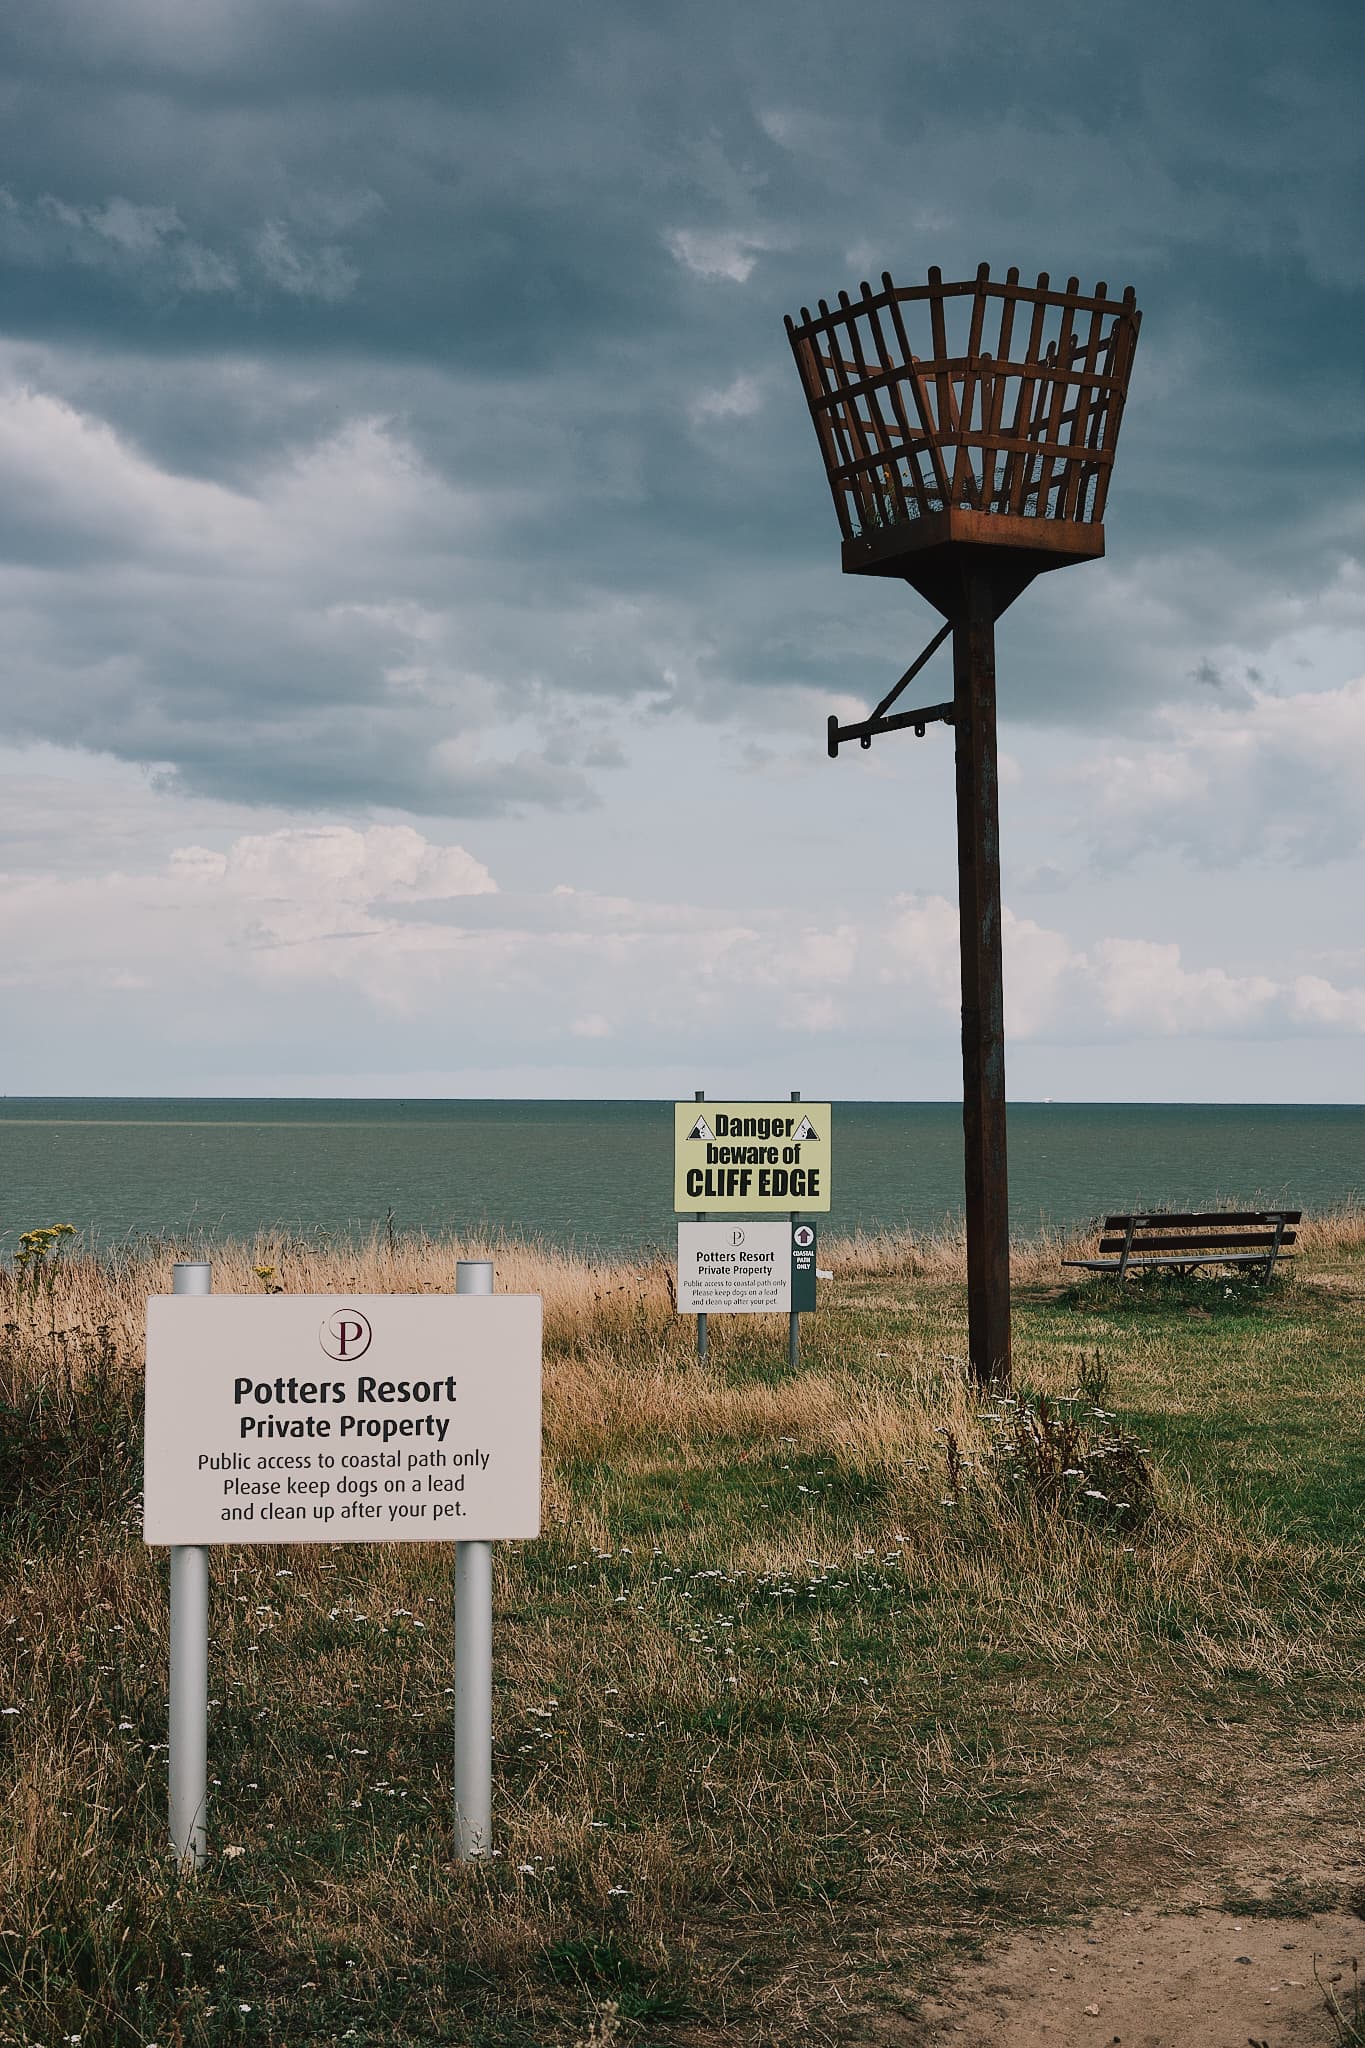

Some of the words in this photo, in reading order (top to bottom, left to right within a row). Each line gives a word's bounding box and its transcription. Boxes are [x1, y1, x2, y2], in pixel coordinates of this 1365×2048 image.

[716, 1114, 794, 1140] Danger
[707, 1143, 778, 1164] beware
[783, 1143, 800, 1164] of
[686, 1169, 752, 1197] CLIFF
[759, 1169, 820, 1197] EDGE
[696, 1252, 735, 1262] Potters
[740, 1252, 775, 1262] Resort
[699, 1266, 730, 1274] Private
[734, 1266, 772, 1276] Property
[234, 1377, 346, 1404] Potters
[357, 1376, 457, 1403] Resort
[240, 1415, 331, 1438] Private
[340, 1414, 450, 1442] Property
[199, 1453, 251, 1470] Public
[257, 1456, 311, 1470] access
[318, 1453, 335, 1468] to
[341, 1450, 401, 1468] coastal
[408, 1450, 447, 1471] path
[453, 1448, 490, 1470] only
[224, 1477, 281, 1495] Please
[287, 1476, 330, 1497] keep
[337, 1476, 378, 1497] dogs
[384, 1478, 405, 1492] on
[412, 1479, 421, 1492] a
[428, 1474, 465, 1492] lead
[221, 1503, 254, 1521] and
[260, 1503, 306, 1520] clean
[313, 1505, 335, 1523] up
[341, 1501, 383, 1519] after
[388, 1504, 426, 1522] your
[433, 1501, 467, 1521] pet.
